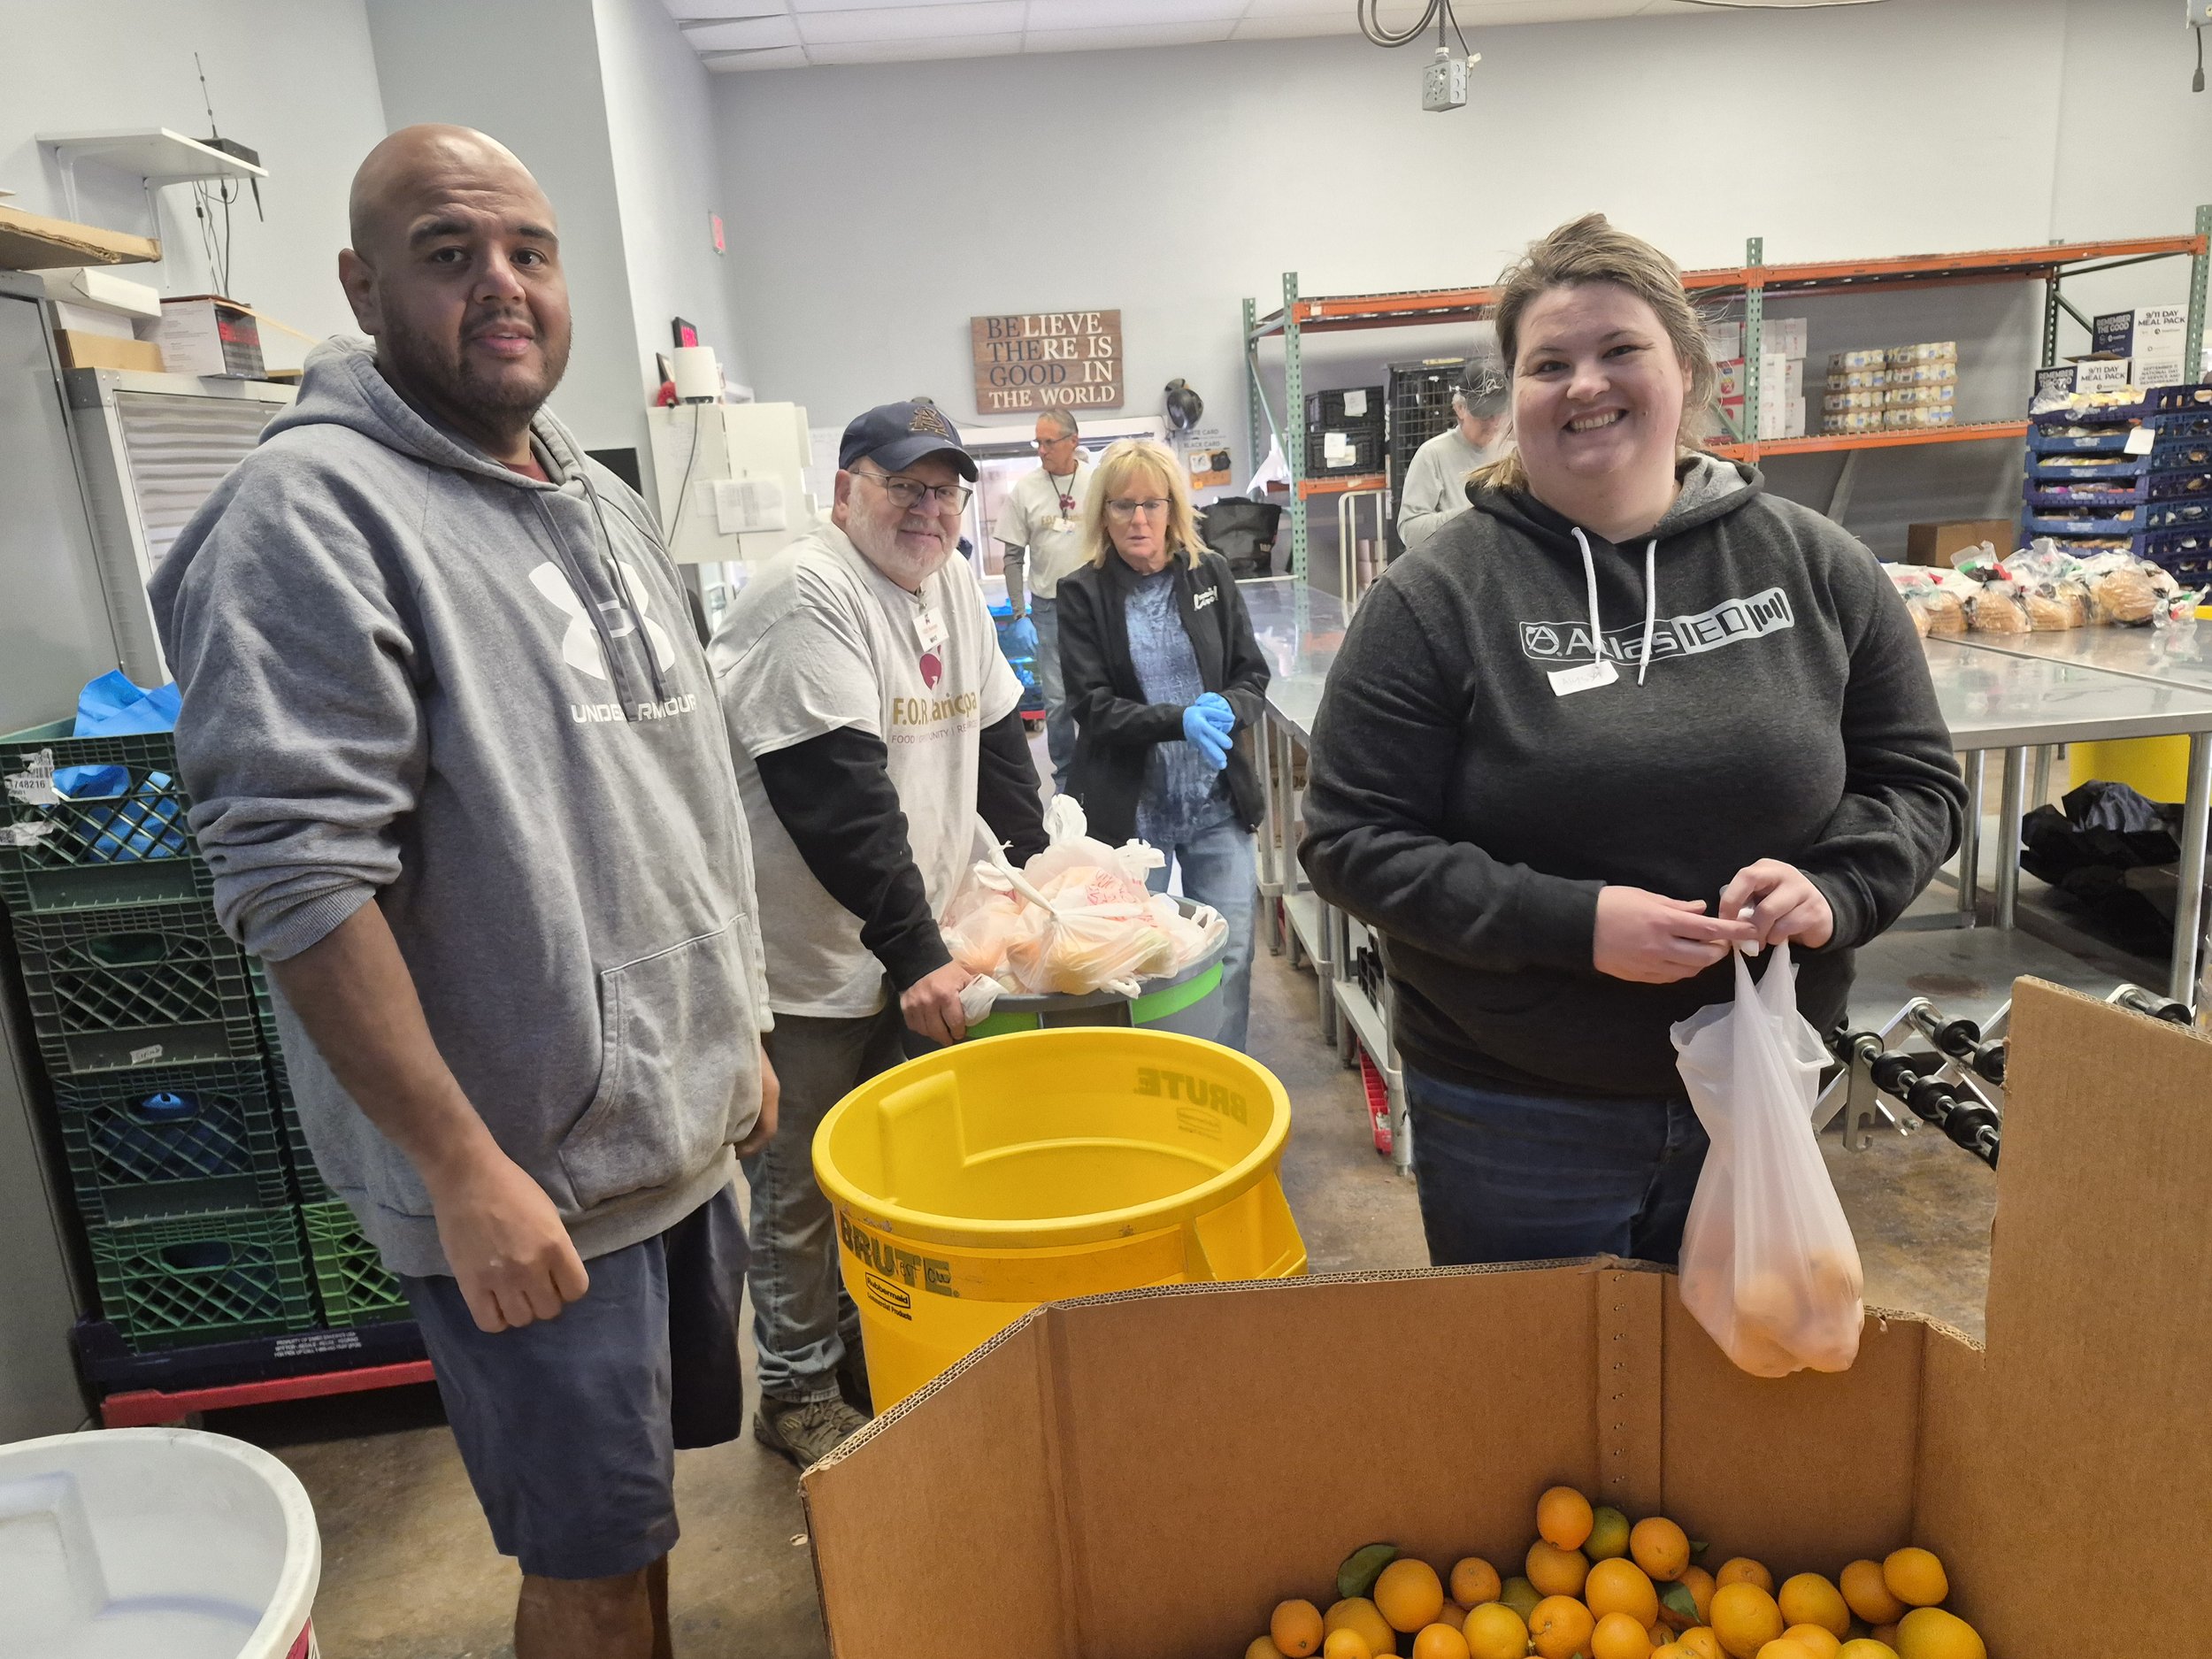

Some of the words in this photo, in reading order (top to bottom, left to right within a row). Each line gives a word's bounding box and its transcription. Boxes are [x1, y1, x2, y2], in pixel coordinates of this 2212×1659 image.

[987, 312, 1102, 340] BELIEVE
[2109, 322, 2130, 332] GOOD
[987, 337, 1079, 363] THERE
[1087, 336, 1113, 358] IS
[989, 363, 1066, 388] GOOD
[1083, 360, 1114, 383] IN
[988, 389, 1033, 409] THE
[1039, 386, 1116, 406] WORLD
[571, 703, 626, 723] UNDE
[637, 694, 696, 721] RMOUR
[891, 734, 916, 744] FOOD
[840, 1211, 954, 1298] BRUTE
[866, 1277, 909, 1304] Rubbermaid
[891, 1306, 913, 1321] Products
